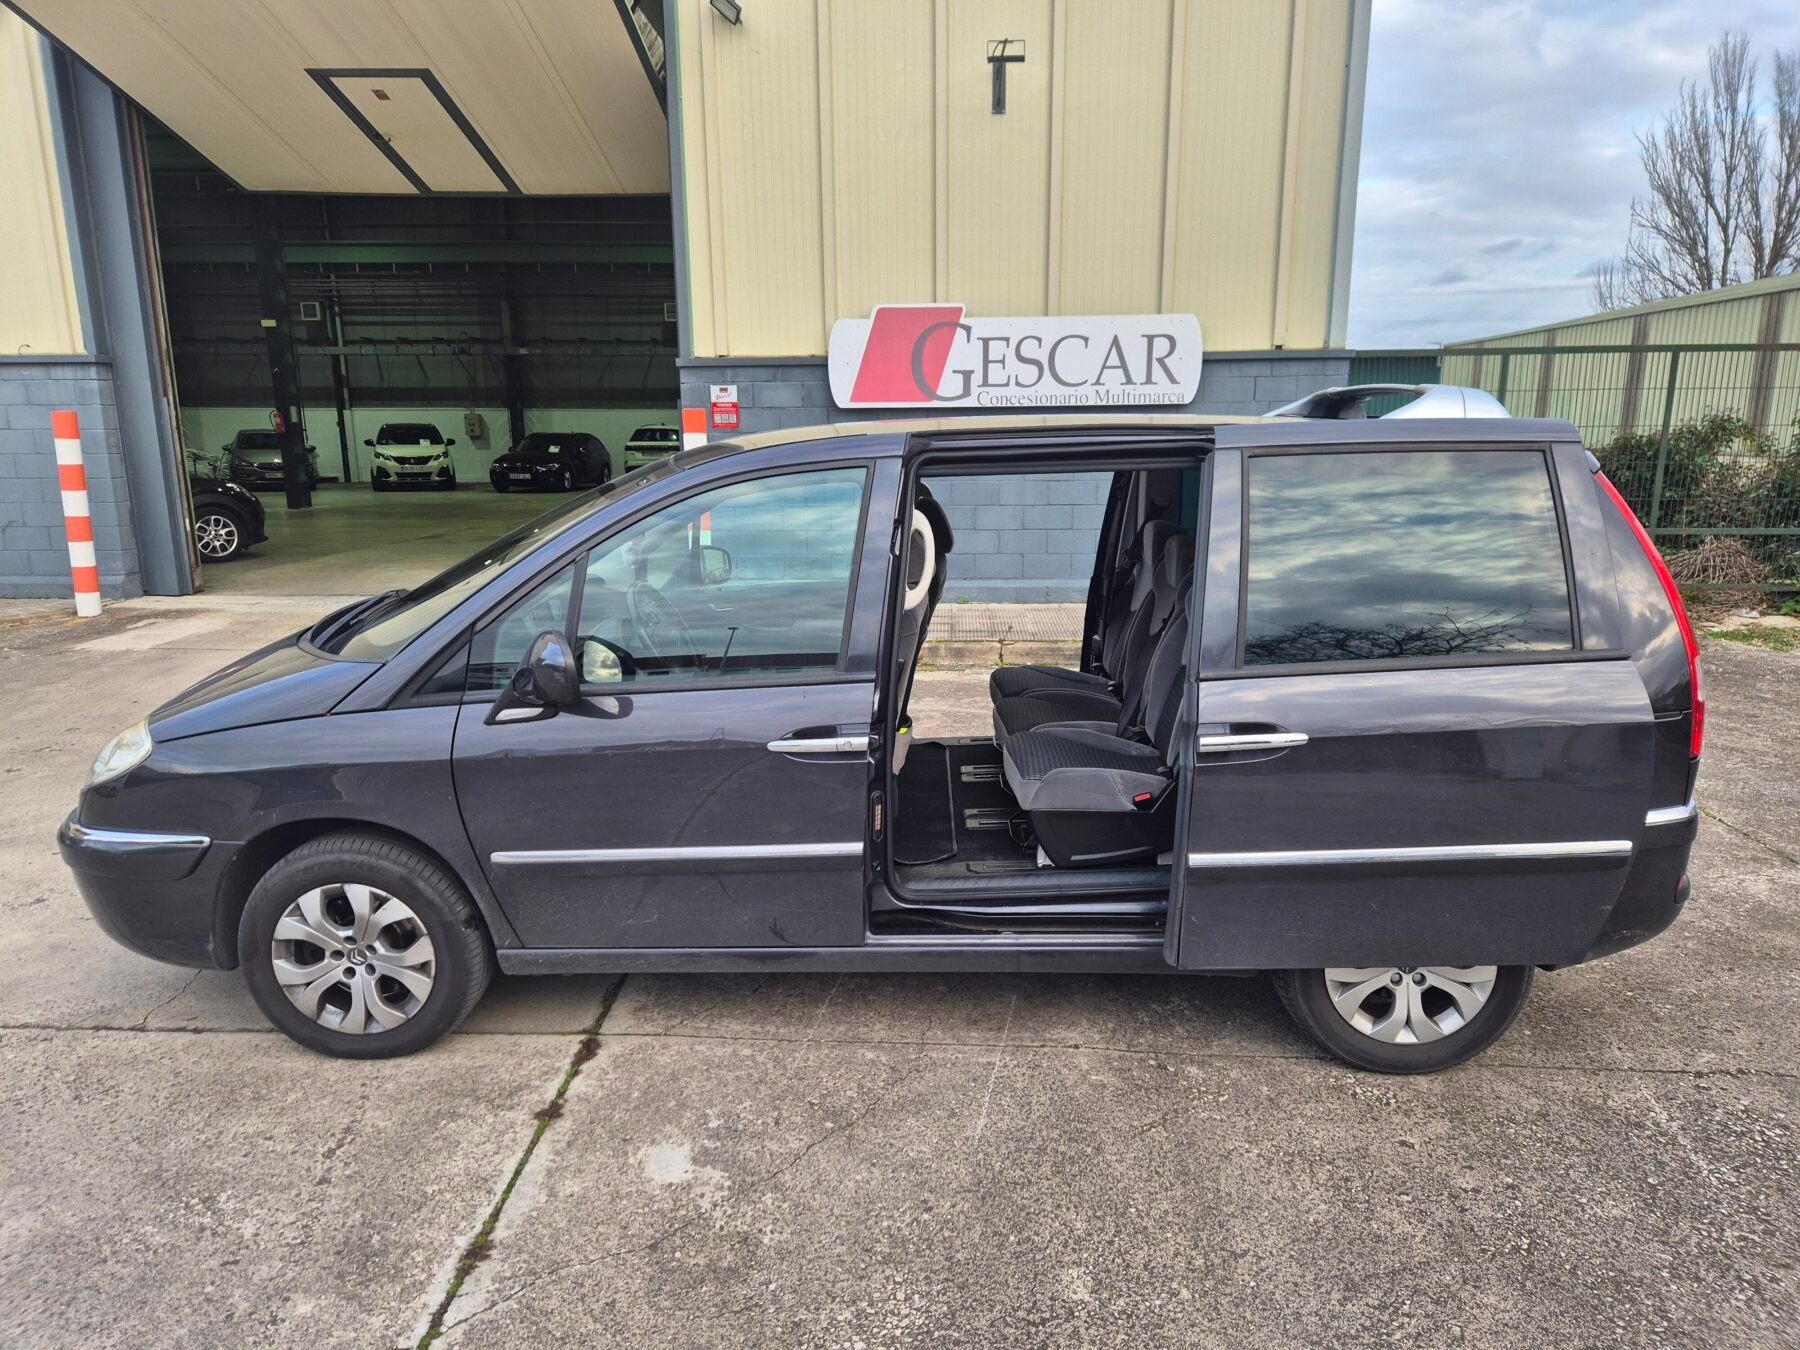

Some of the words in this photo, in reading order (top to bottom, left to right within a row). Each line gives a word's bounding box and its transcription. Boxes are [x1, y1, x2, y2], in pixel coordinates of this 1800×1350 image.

[911, 321, 1180, 401] GESCAR
[977, 390, 1089, 406] Concesionario
[1095, 389, 1185, 404] Multimarca
